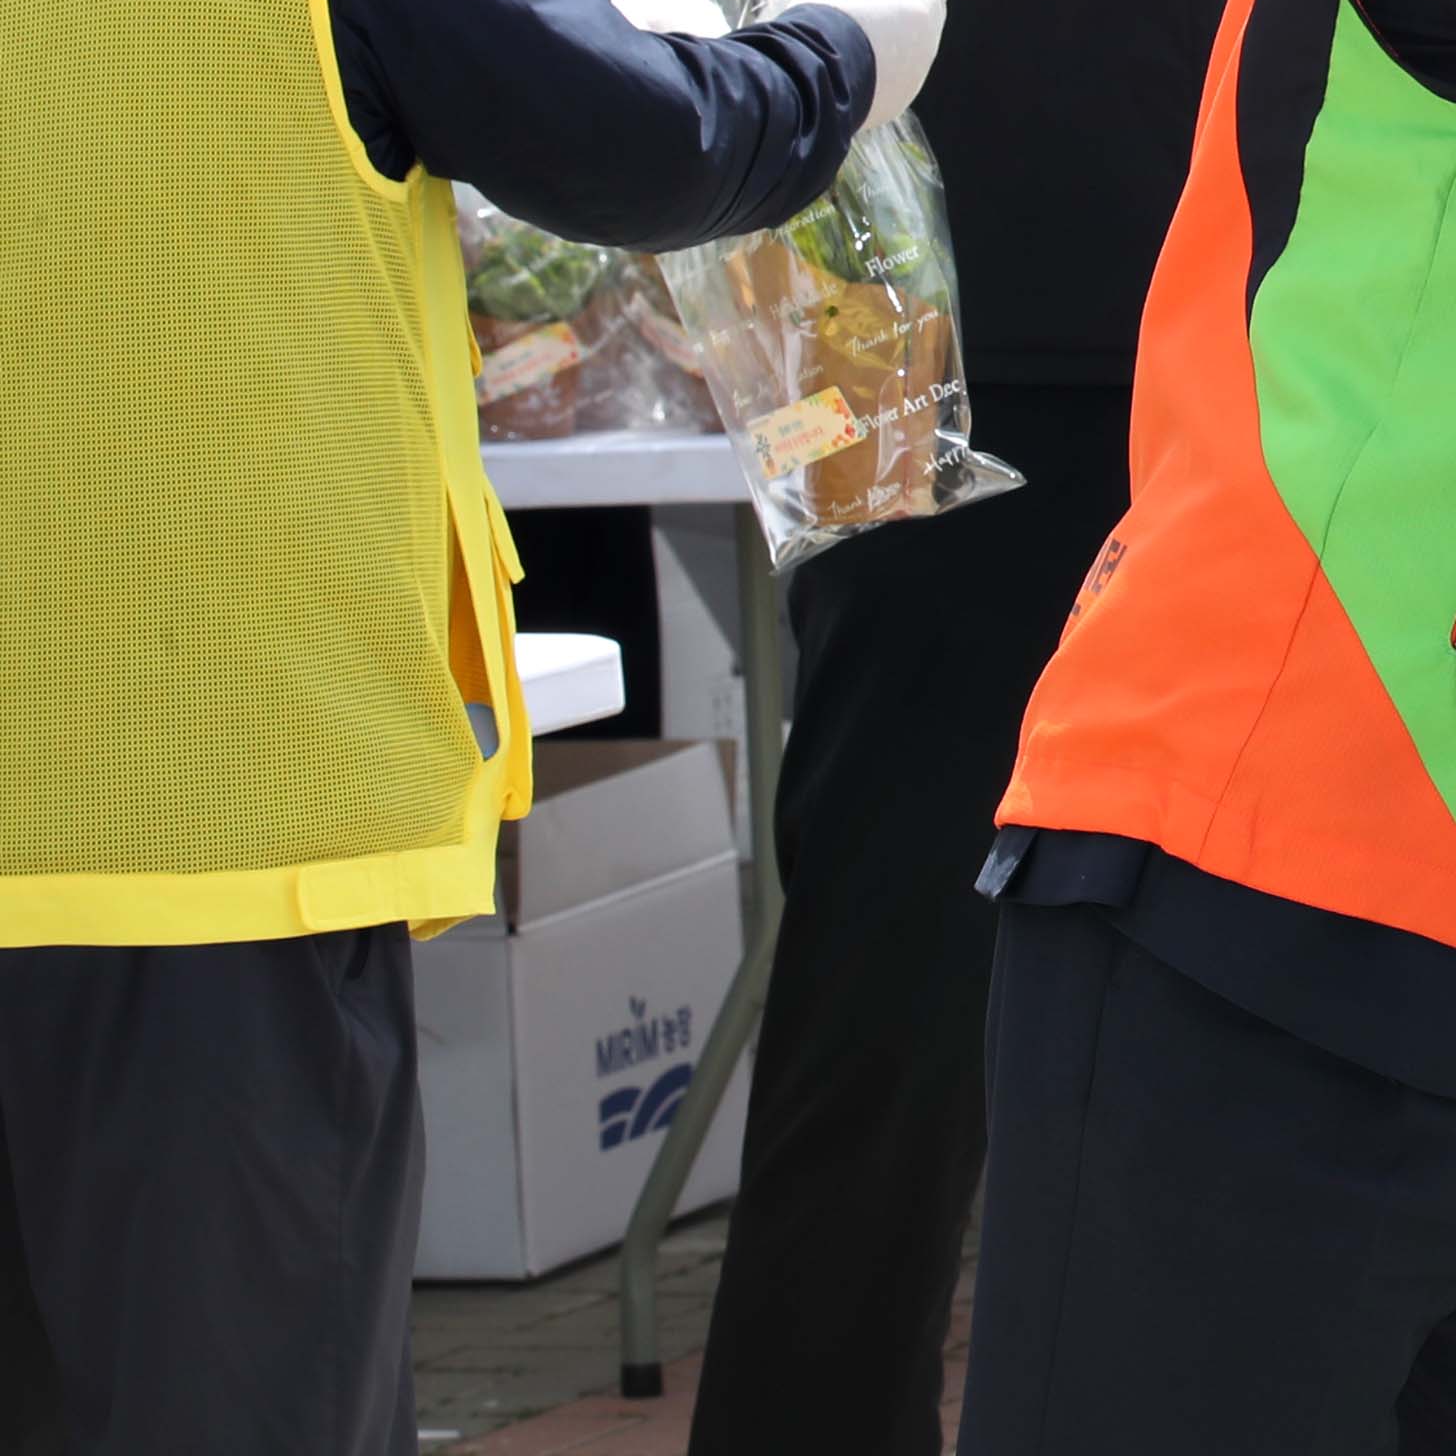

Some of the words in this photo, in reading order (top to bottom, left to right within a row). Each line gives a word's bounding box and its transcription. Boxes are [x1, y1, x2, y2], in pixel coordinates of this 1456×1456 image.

[865, 243, 921, 279] Flower
[846, 331, 892, 357] Thank
[916, 308, 940, 335] you
[903, 395, 930, 418] Art
